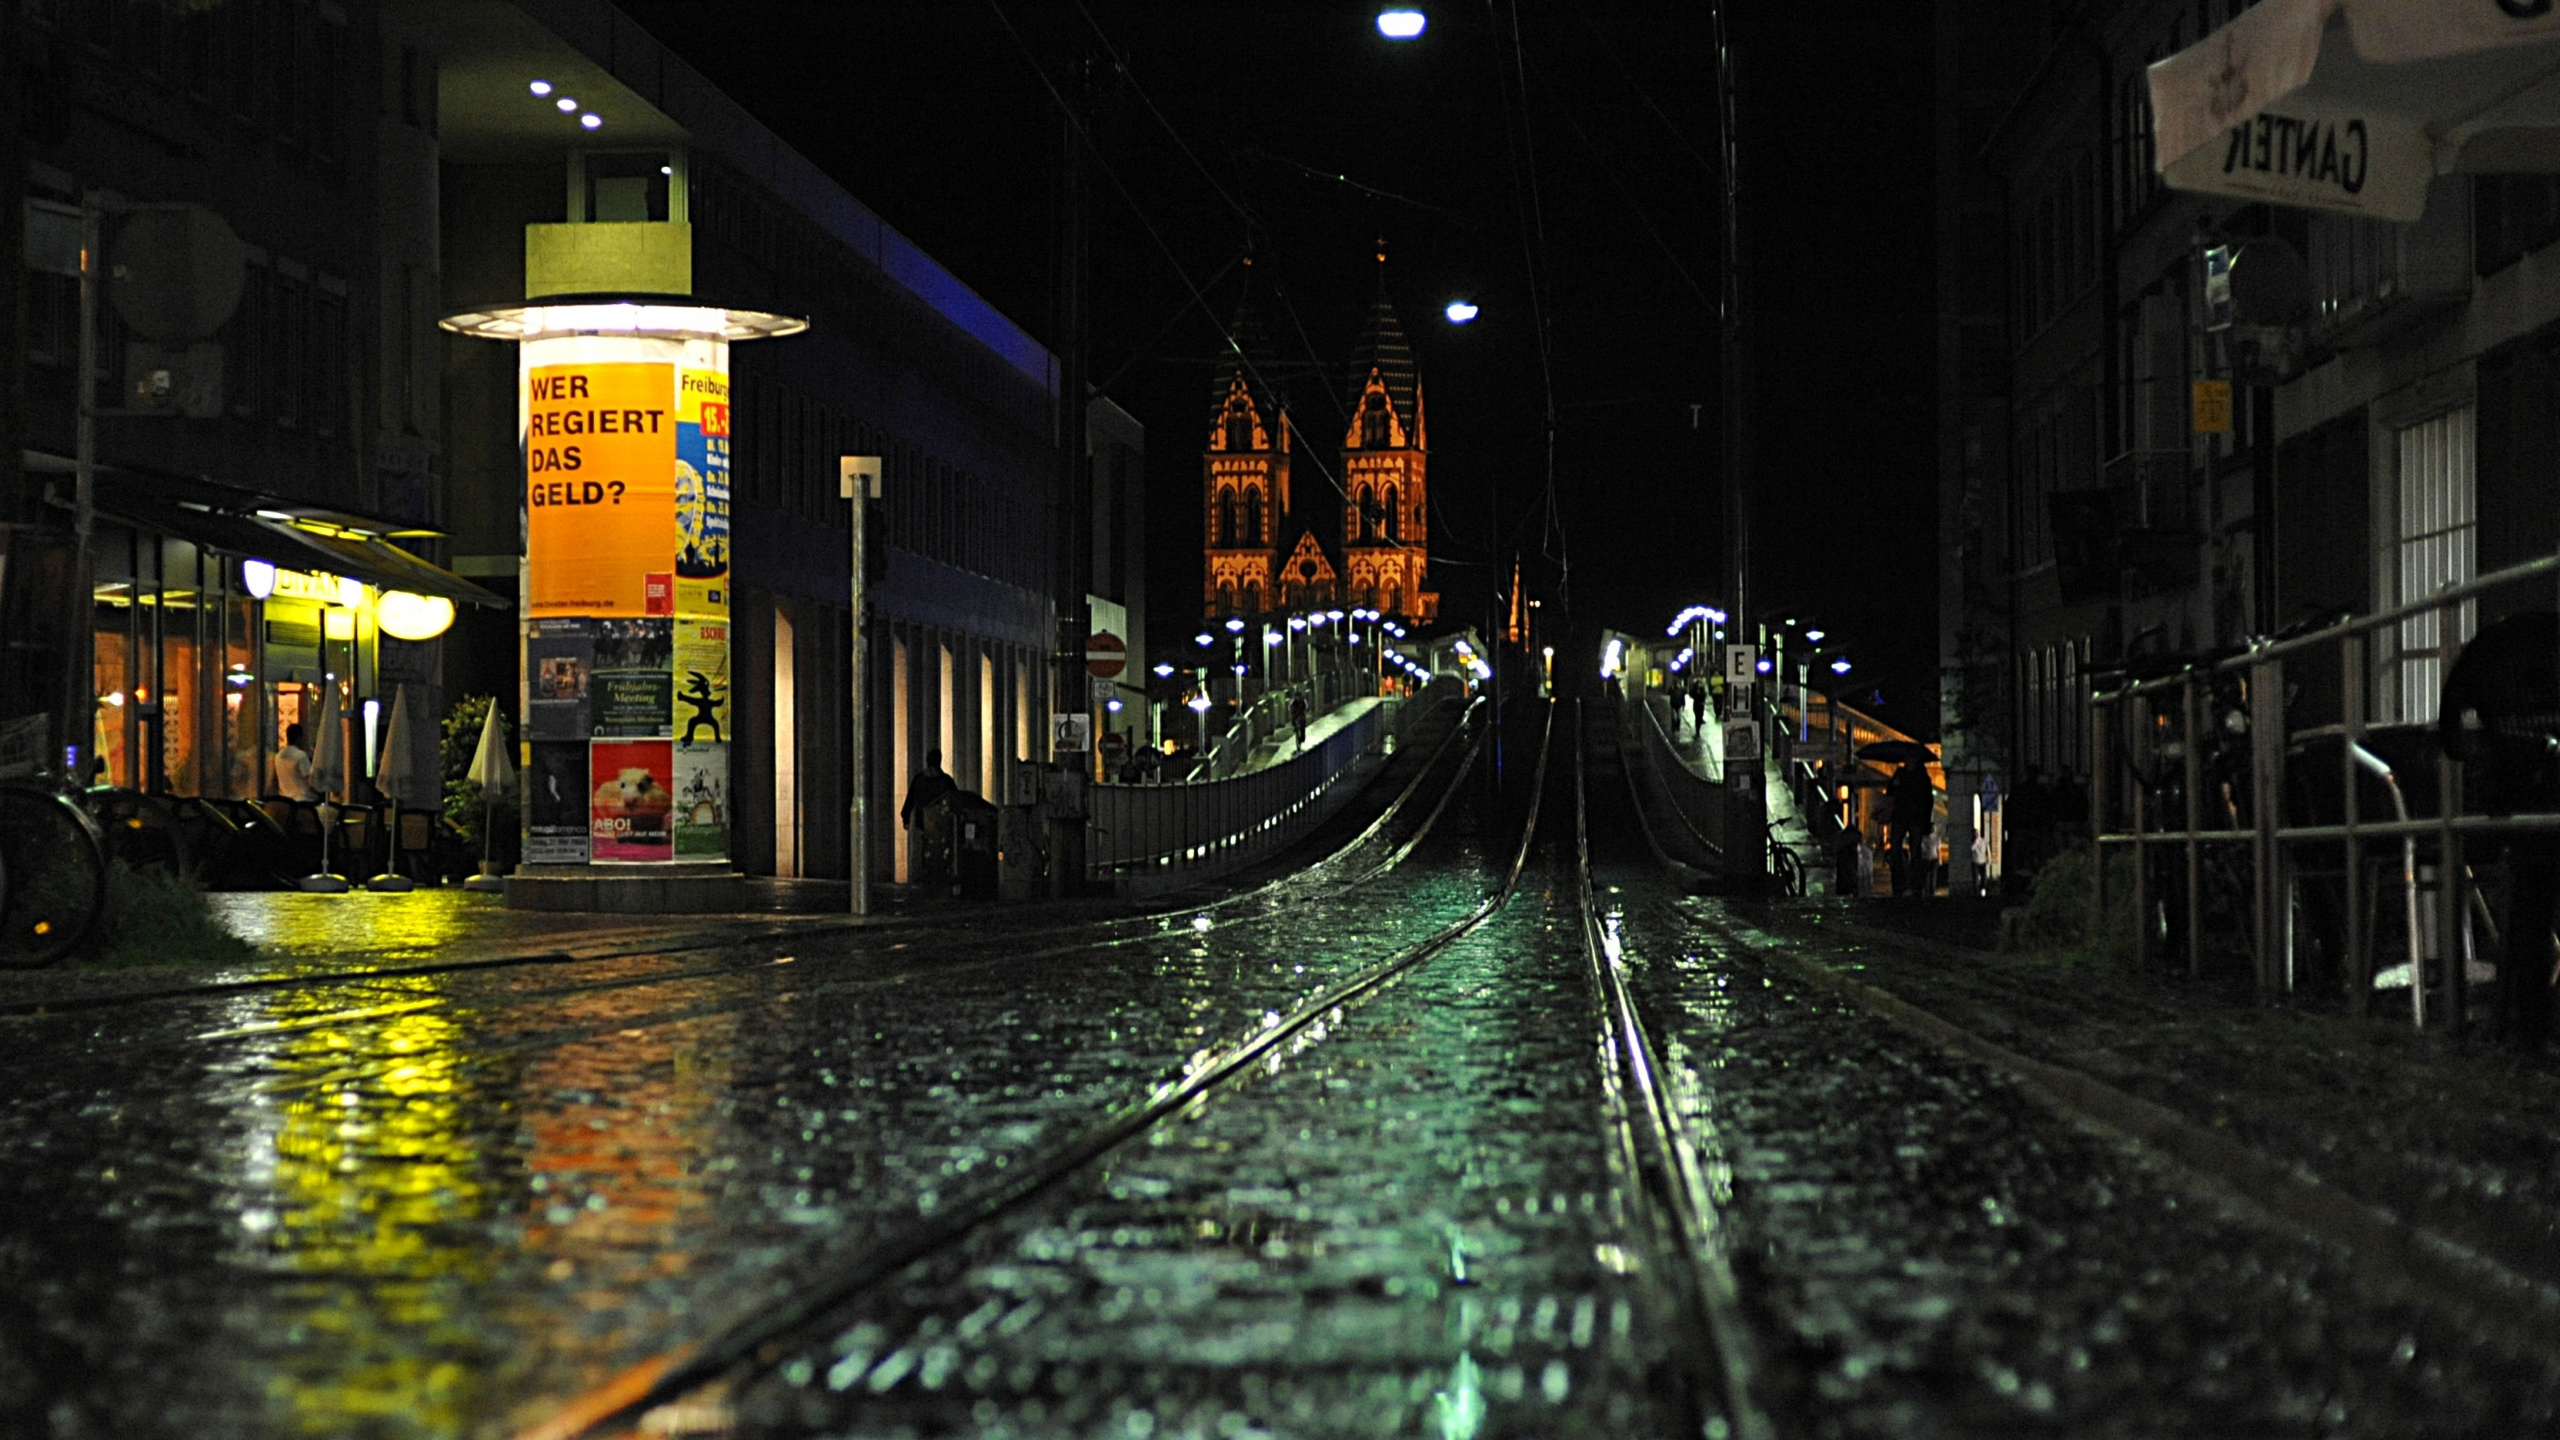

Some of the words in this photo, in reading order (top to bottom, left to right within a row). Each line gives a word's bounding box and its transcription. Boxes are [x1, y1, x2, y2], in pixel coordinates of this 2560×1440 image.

[531, 375, 589, 401] WER
[532, 409, 664, 437] REGIERT
[532, 446, 582, 473] DAS
[532, 480, 626, 507] GELD?
[1735, 652, 1744, 675] E
[613, 692, 656, 705] Meeting
[594, 818, 631, 831] ABO!
